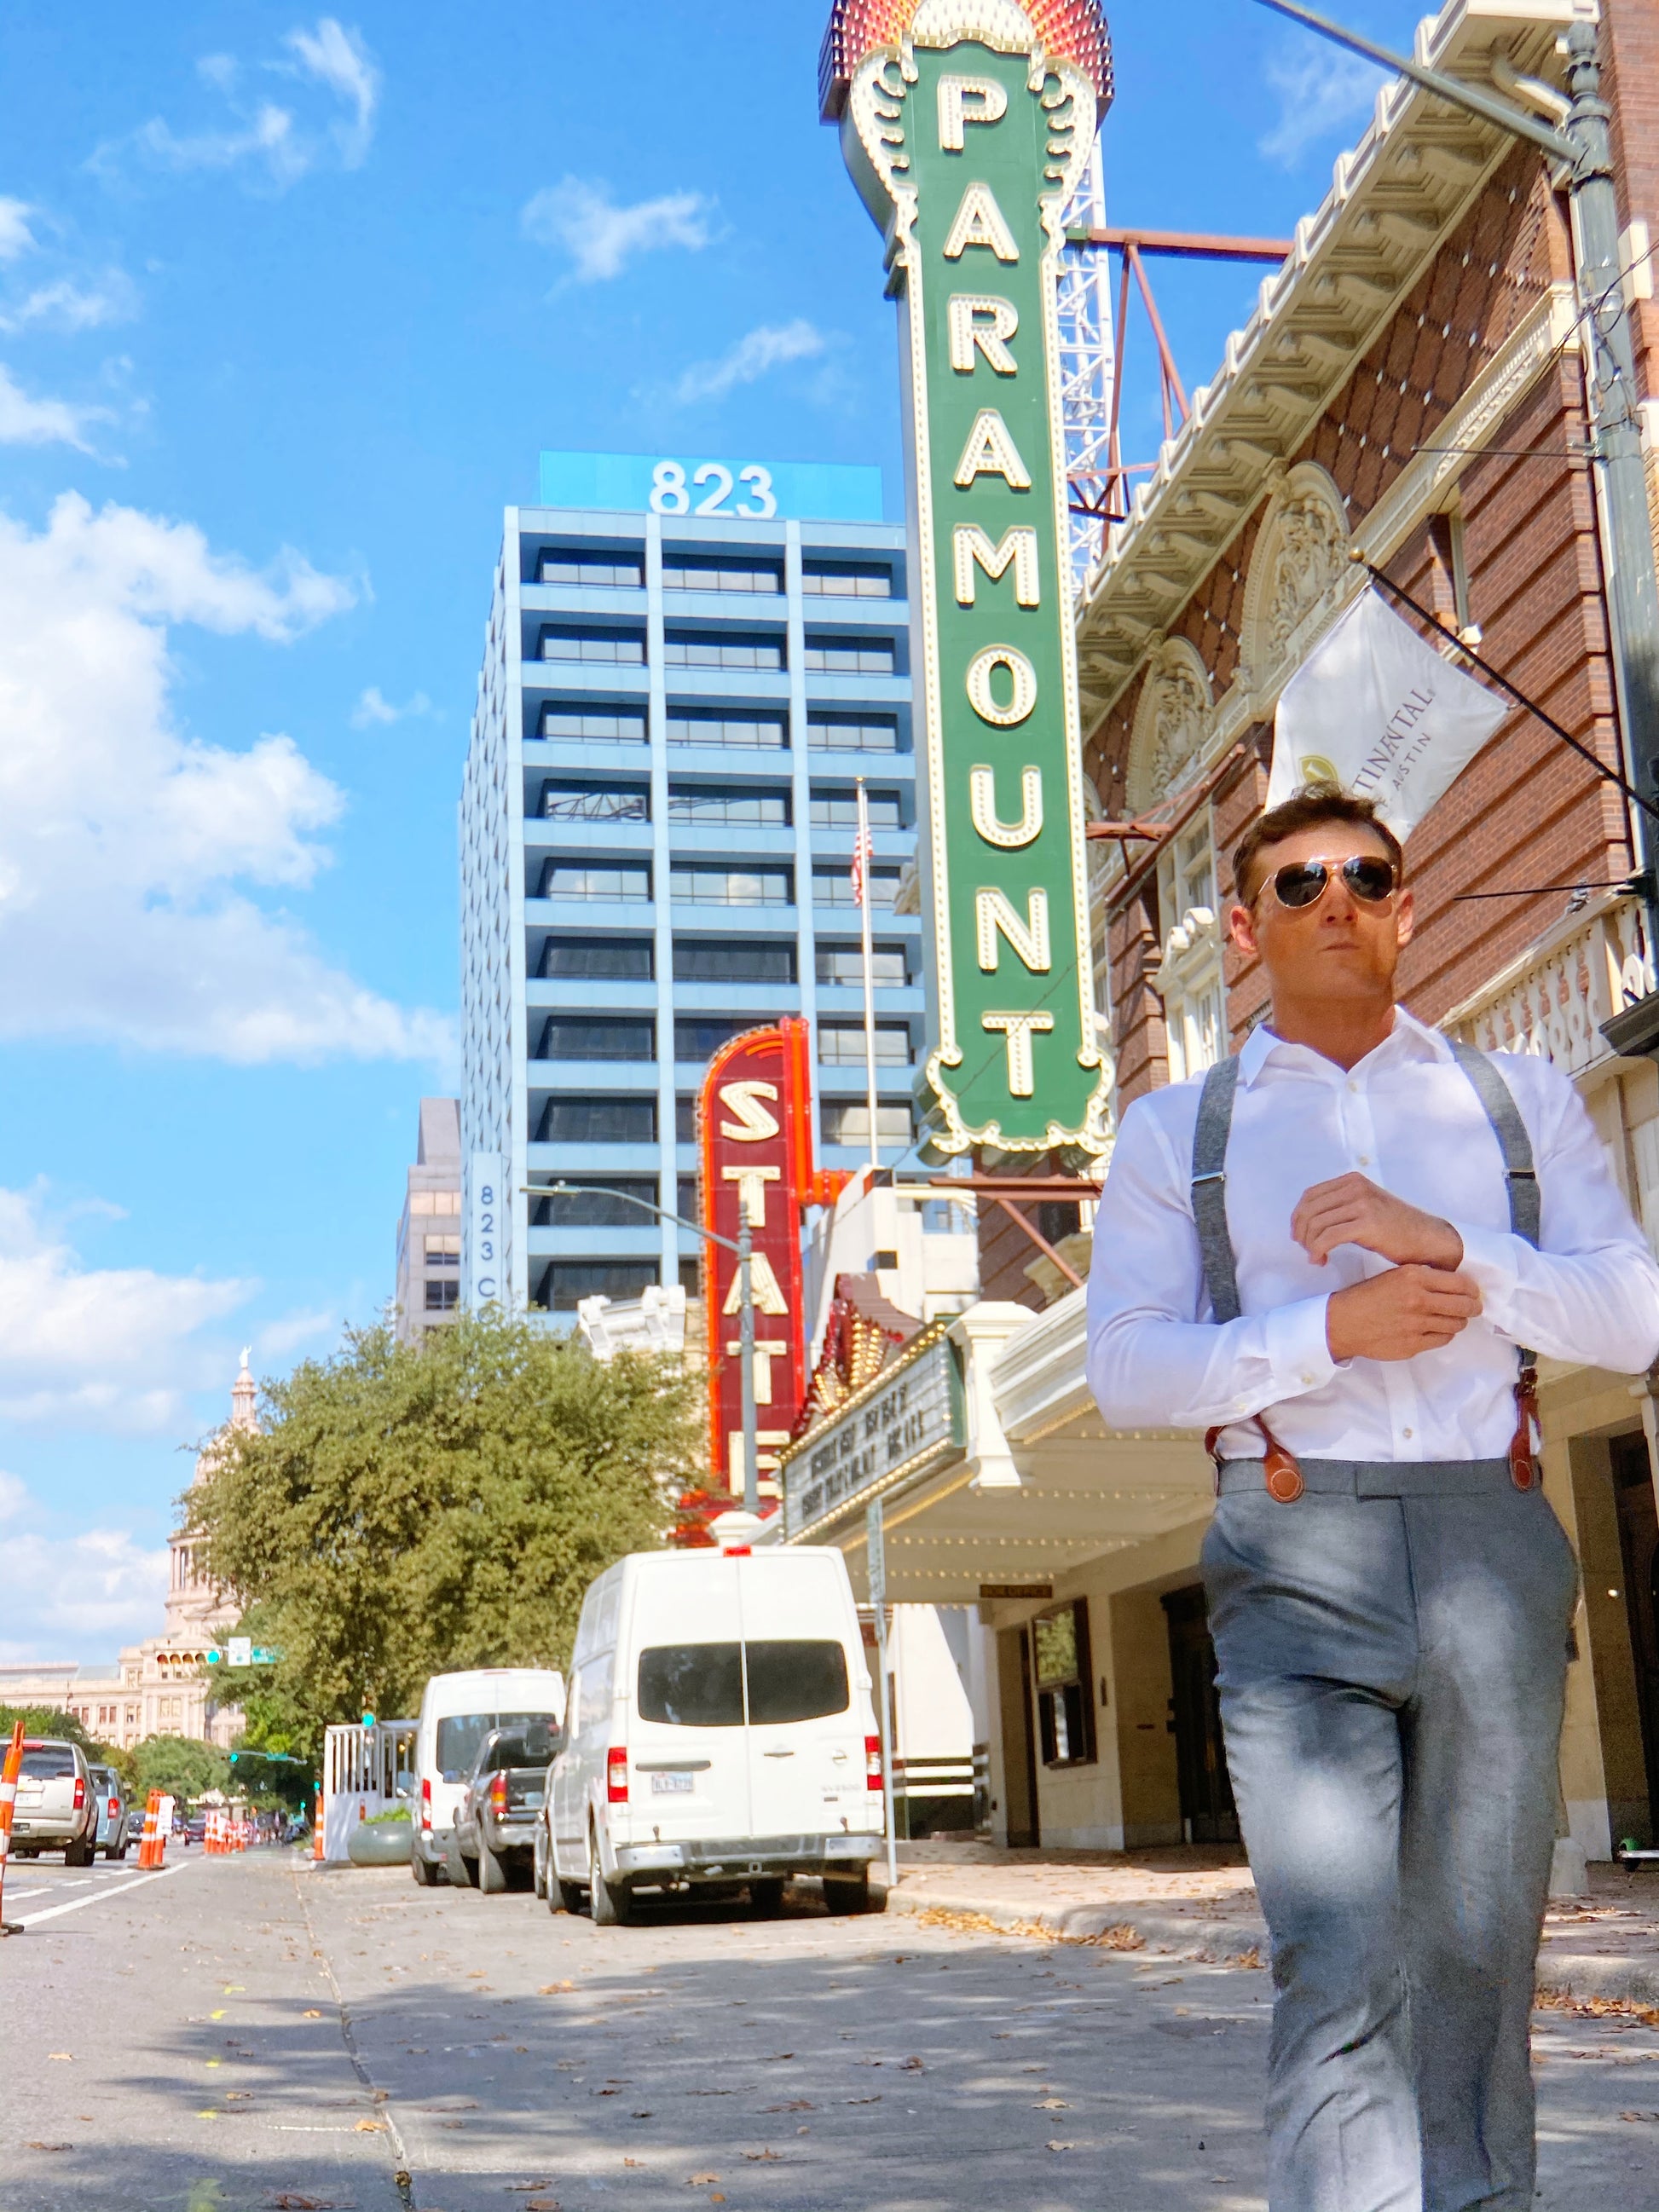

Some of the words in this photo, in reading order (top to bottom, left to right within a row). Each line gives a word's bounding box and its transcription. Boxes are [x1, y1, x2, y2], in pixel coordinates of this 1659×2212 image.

[649, 460, 778, 519] 823
[938, 73, 1055, 1096] PARAMOUNT
[1391, 731, 1432, 792] AUSTIN
[481, 1186, 494, 1262] 823
[719, 1080, 790, 1498] STATE
